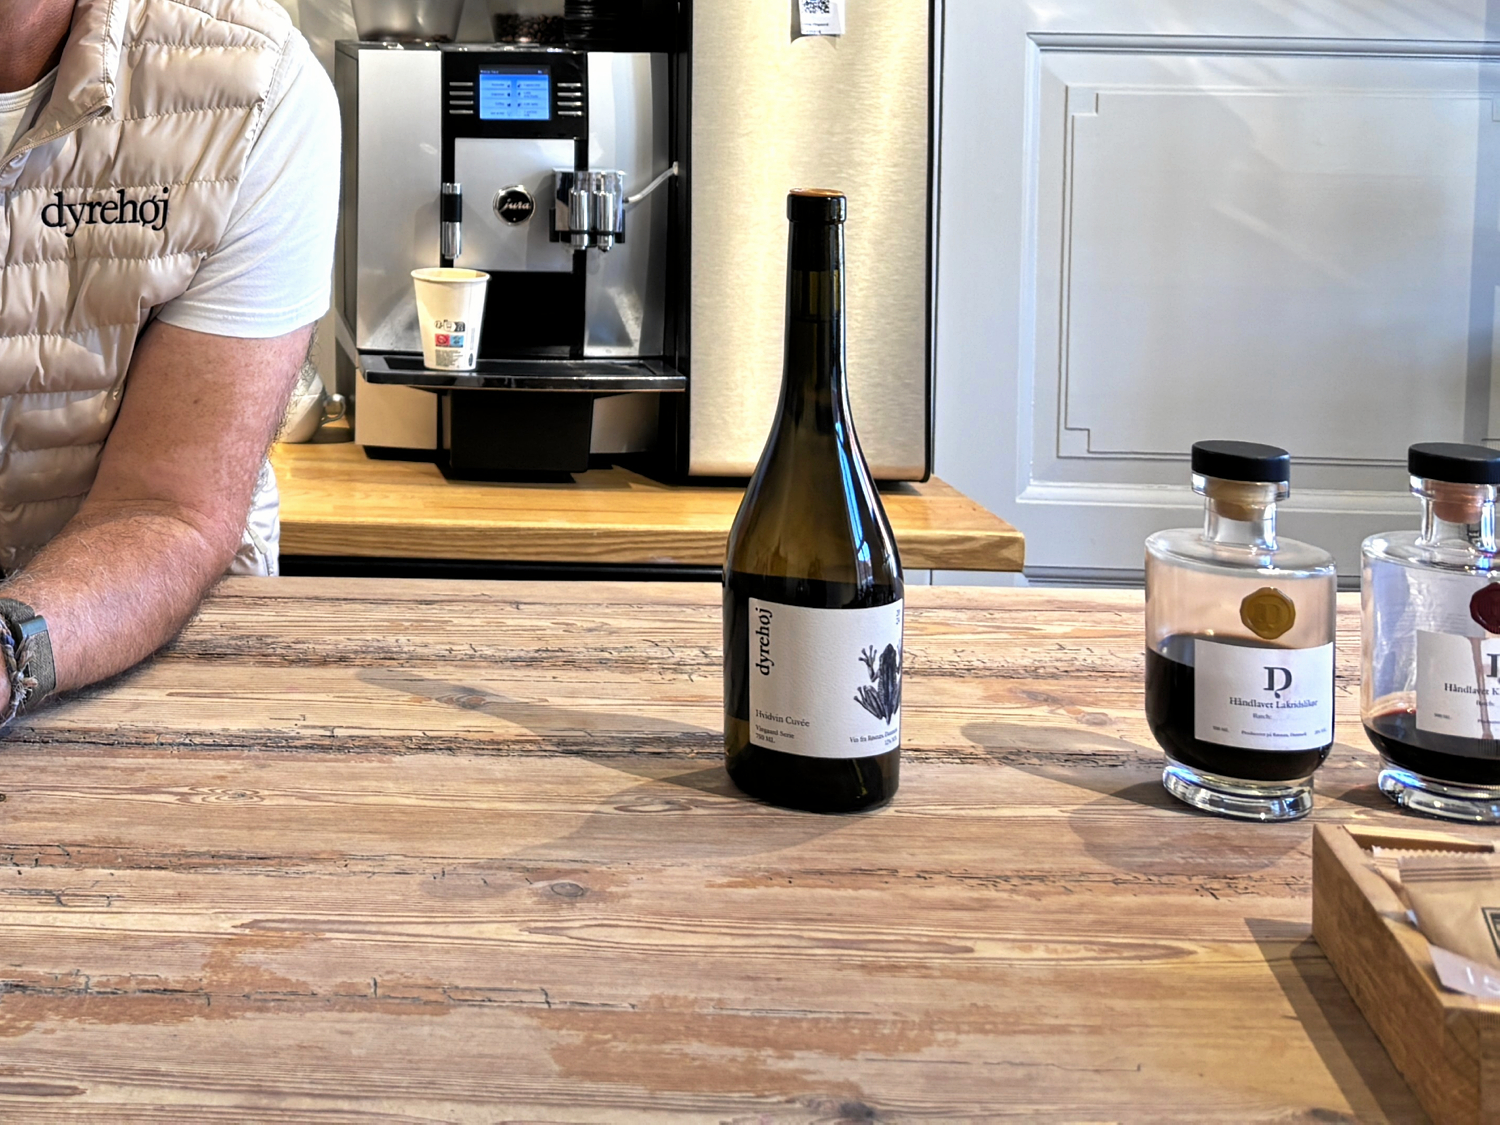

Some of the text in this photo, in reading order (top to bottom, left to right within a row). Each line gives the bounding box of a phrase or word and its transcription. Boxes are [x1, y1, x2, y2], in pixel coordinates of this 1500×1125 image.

[41, 186, 169, 237] dyrehøj
[755, 606, 775, 676] dyrehøj
[1229, 696, 1274, 709] Håndlavet
